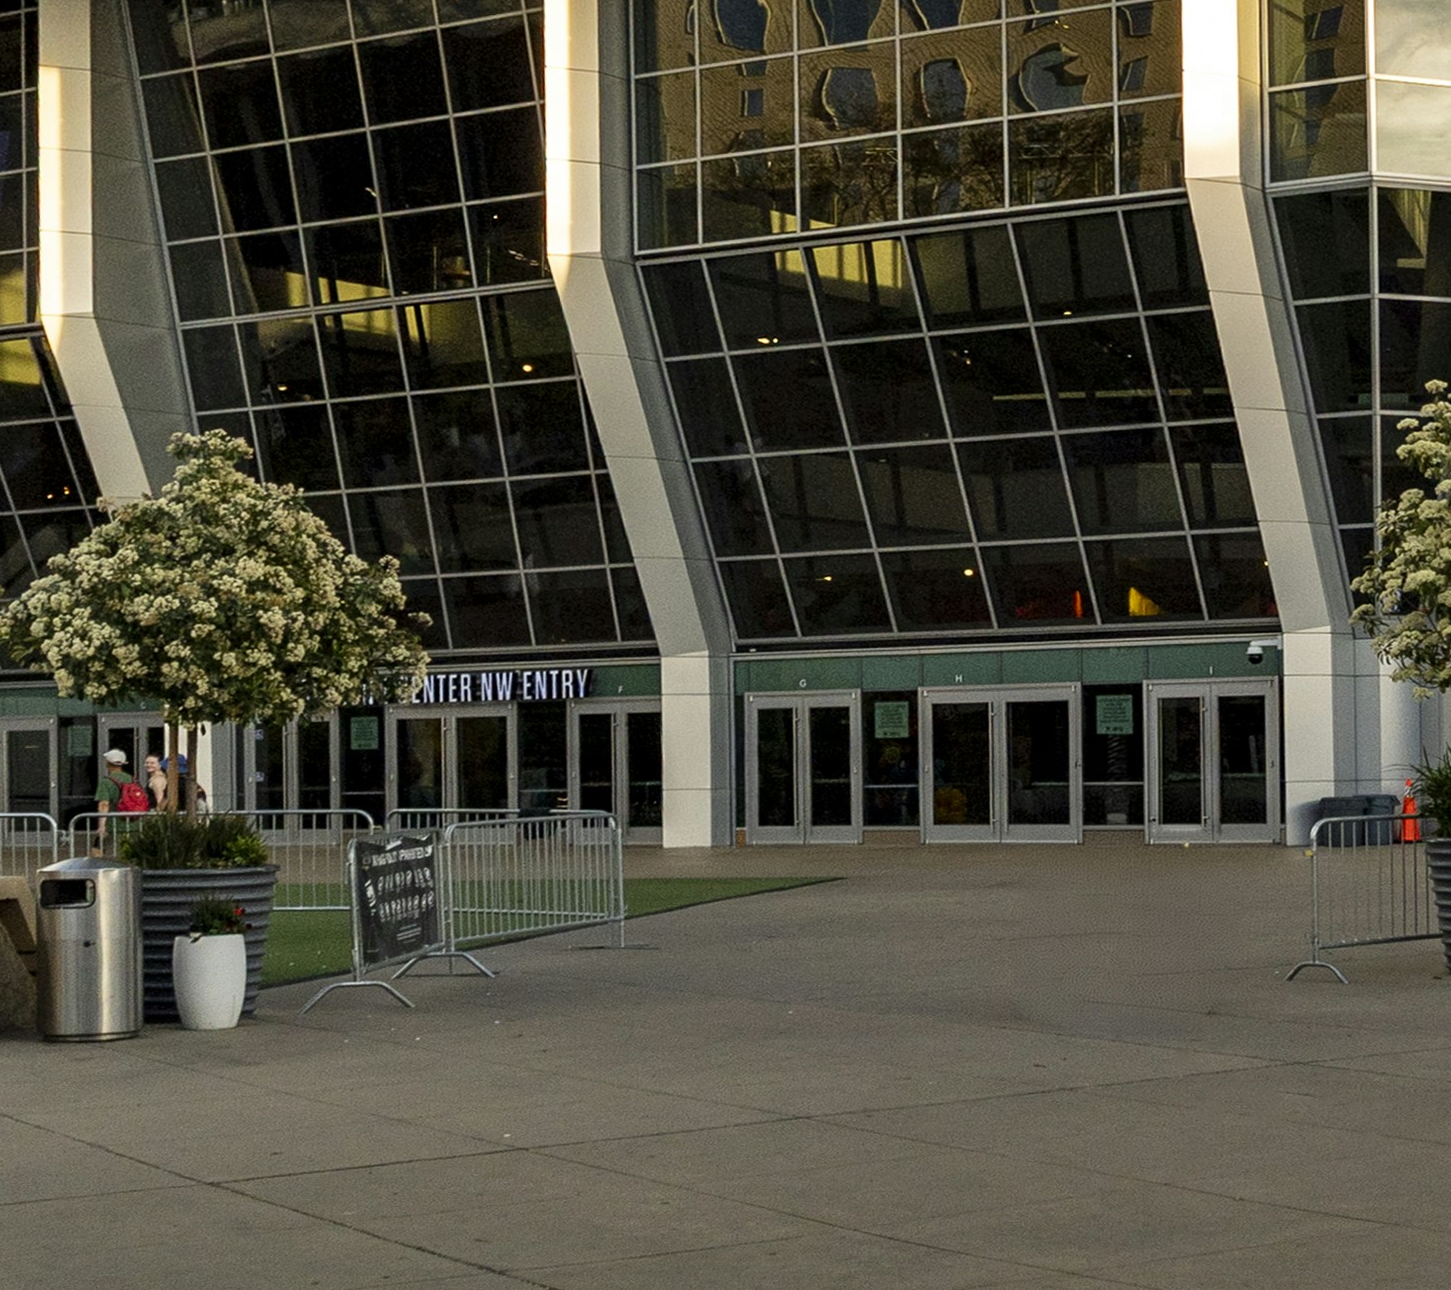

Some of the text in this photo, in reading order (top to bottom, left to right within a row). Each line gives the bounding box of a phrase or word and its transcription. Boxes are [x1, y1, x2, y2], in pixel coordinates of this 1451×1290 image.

[398, 673, 472, 704] ENTER
[480, 671, 514, 701] NW
[522, 668, 589, 700] ENTRY
